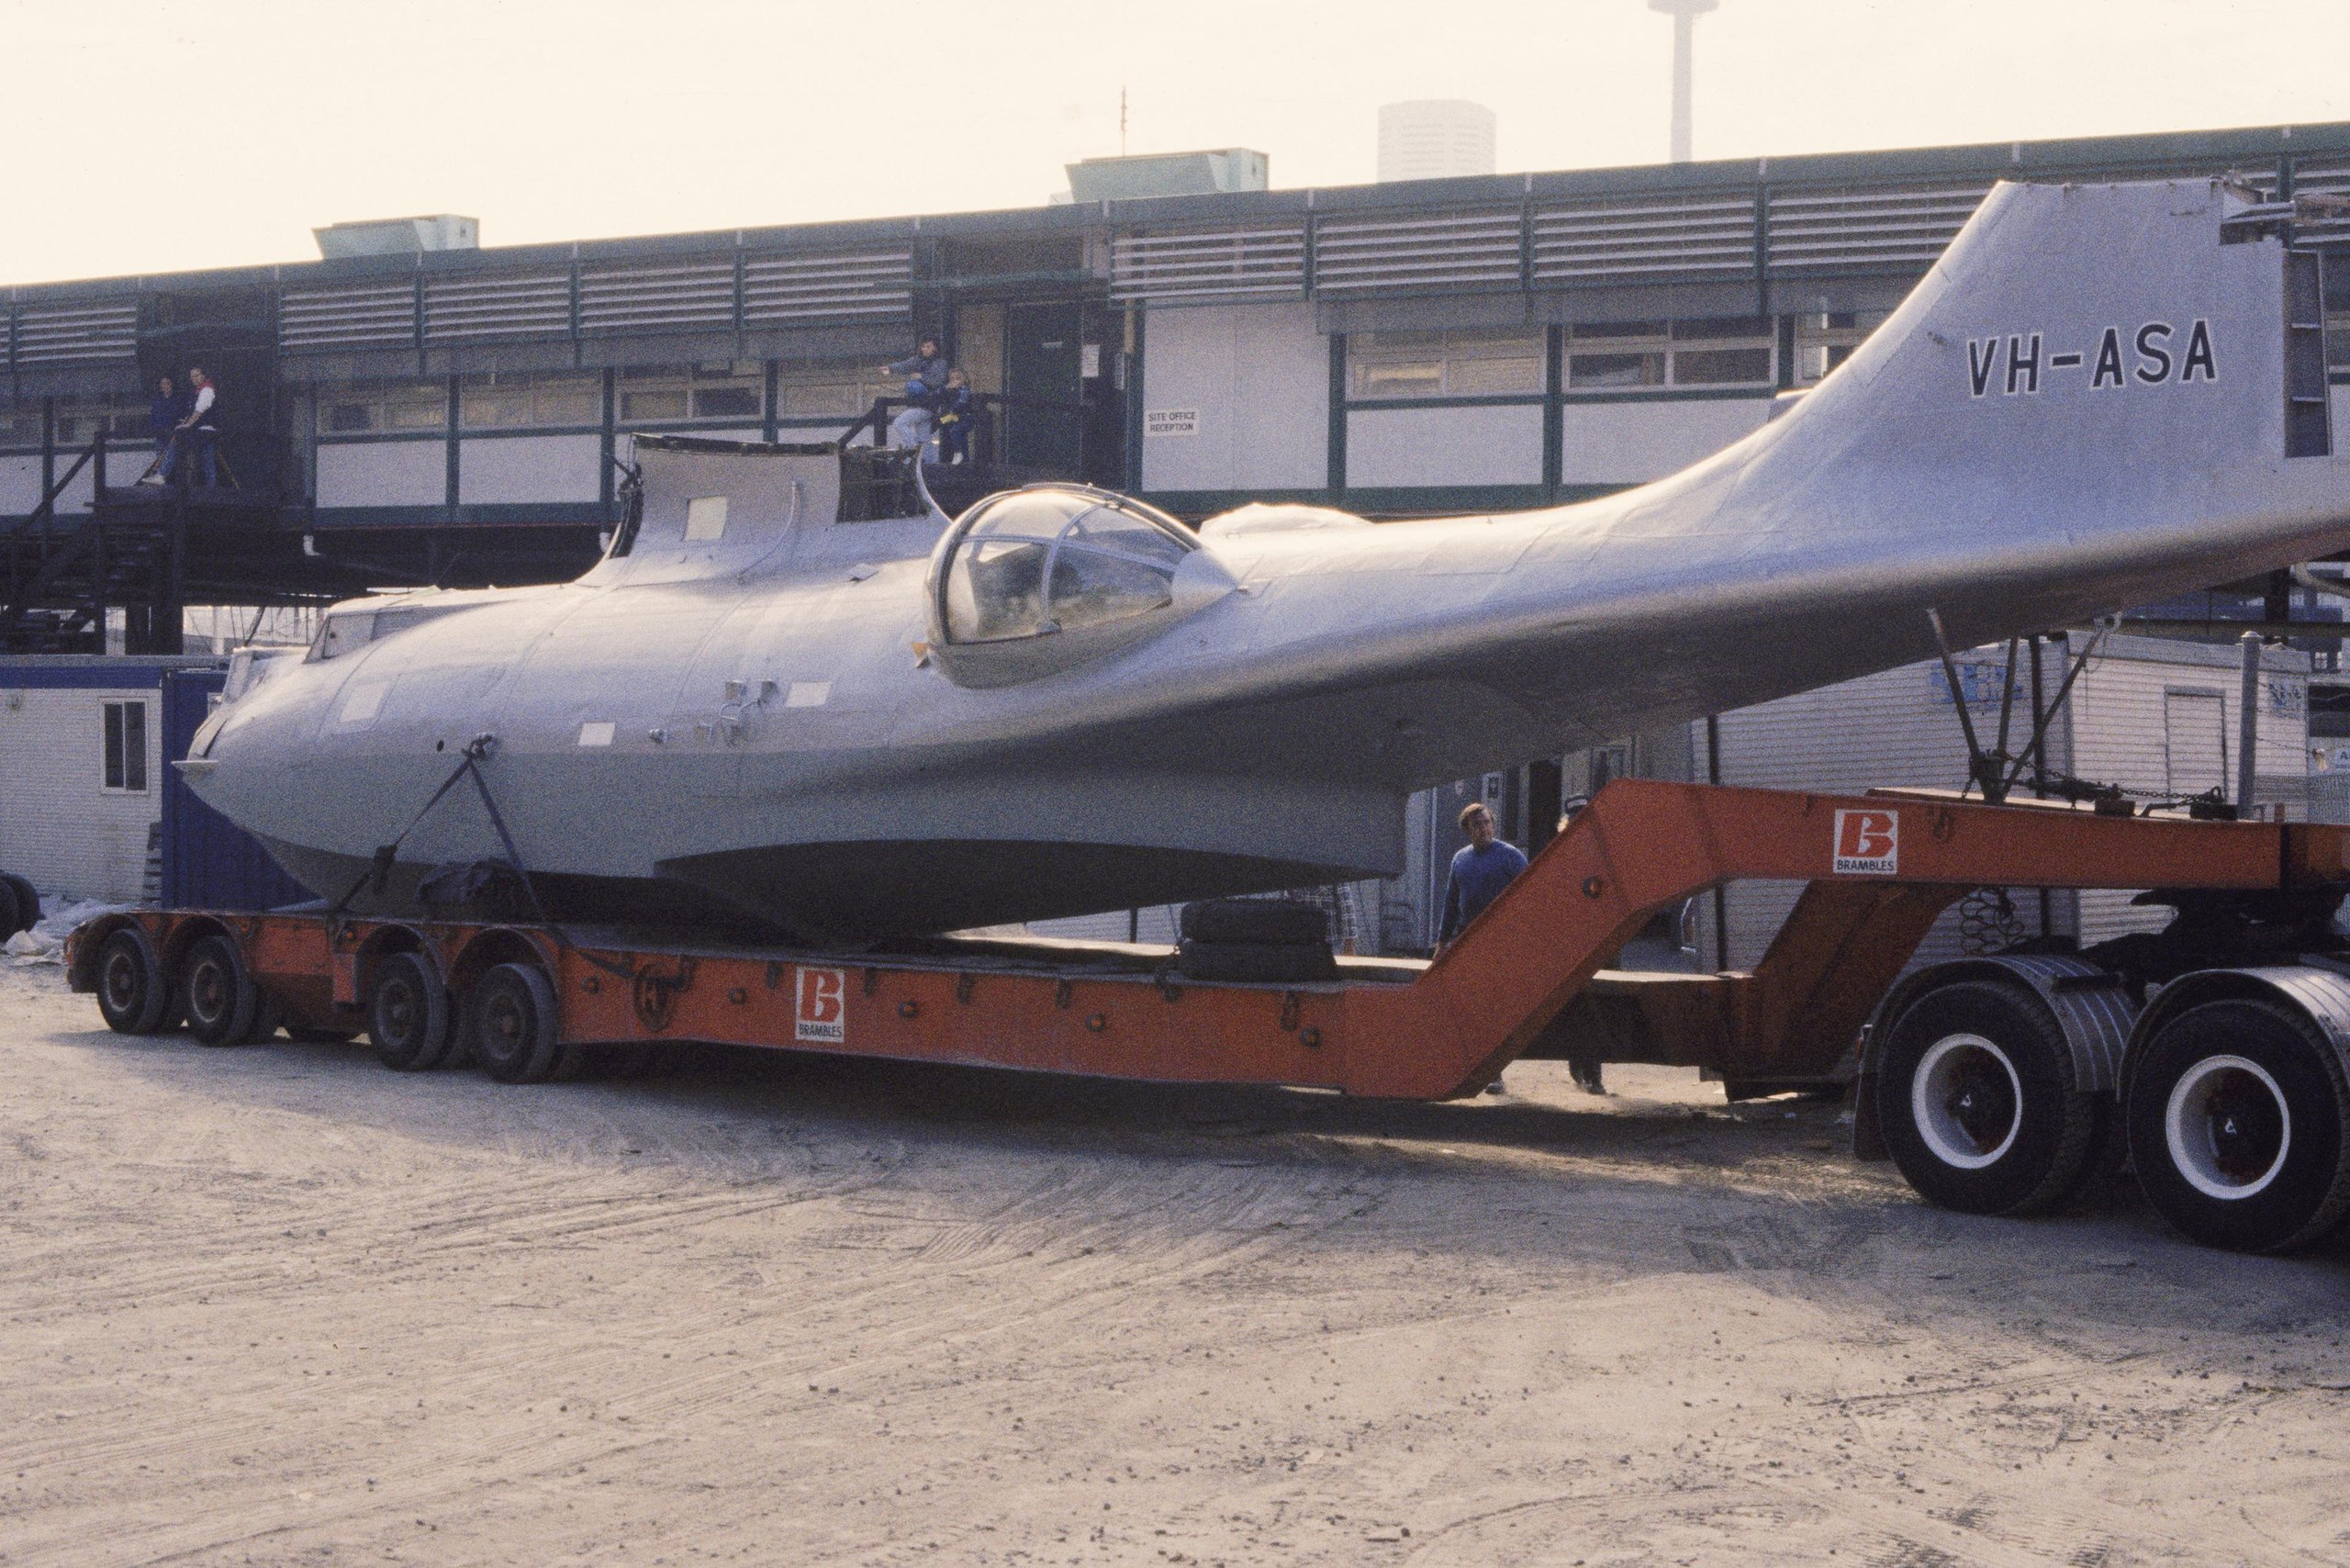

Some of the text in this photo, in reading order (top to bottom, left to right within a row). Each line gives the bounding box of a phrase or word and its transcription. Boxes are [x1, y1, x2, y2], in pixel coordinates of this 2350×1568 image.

[1968, 319, 2217, 398] VH-ASA
[1148, 411, 1196, 421] SITE OFFICE
[1150, 423, 1193, 432] RECEPTION
[1838, 812, 1895, 857] B
[1837, 859, 1895, 872] BRAMBLES
[799, 969, 841, 1022] B
[799, 1024, 842, 1037] BRAMBLES
